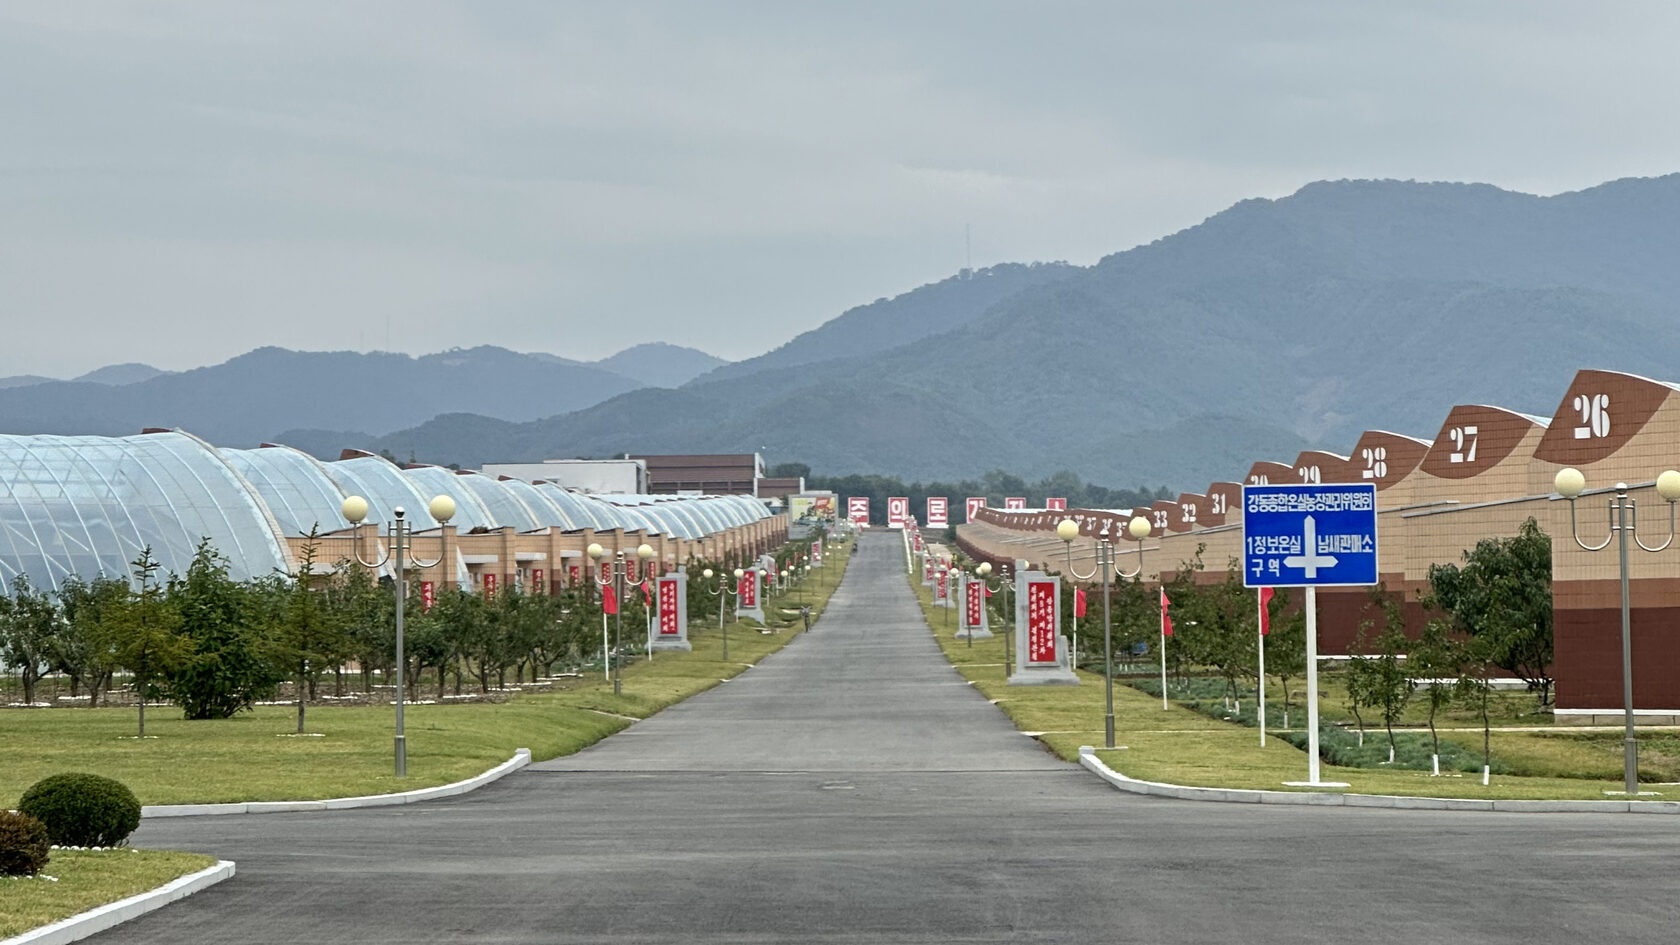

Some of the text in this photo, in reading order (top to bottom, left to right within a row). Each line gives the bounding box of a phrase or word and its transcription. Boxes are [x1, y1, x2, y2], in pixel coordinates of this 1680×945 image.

[1574, 394, 1611, 439] 26
[1450, 426, 1478, 463] 27
[1362, 447, 1387, 479] 28
[1299, 465, 1321, 484] 29
[1212, 493, 1226, 514] 31
[1248, 492, 1373, 513] 강동종합온실농장관리위원회
[1154, 510, 1168, 528] 33
[1182, 503, 1197, 523] 32
[1247, 535, 1301, 555] 1정보온실
[1317, 534, 1374, 554] 남새판매소
